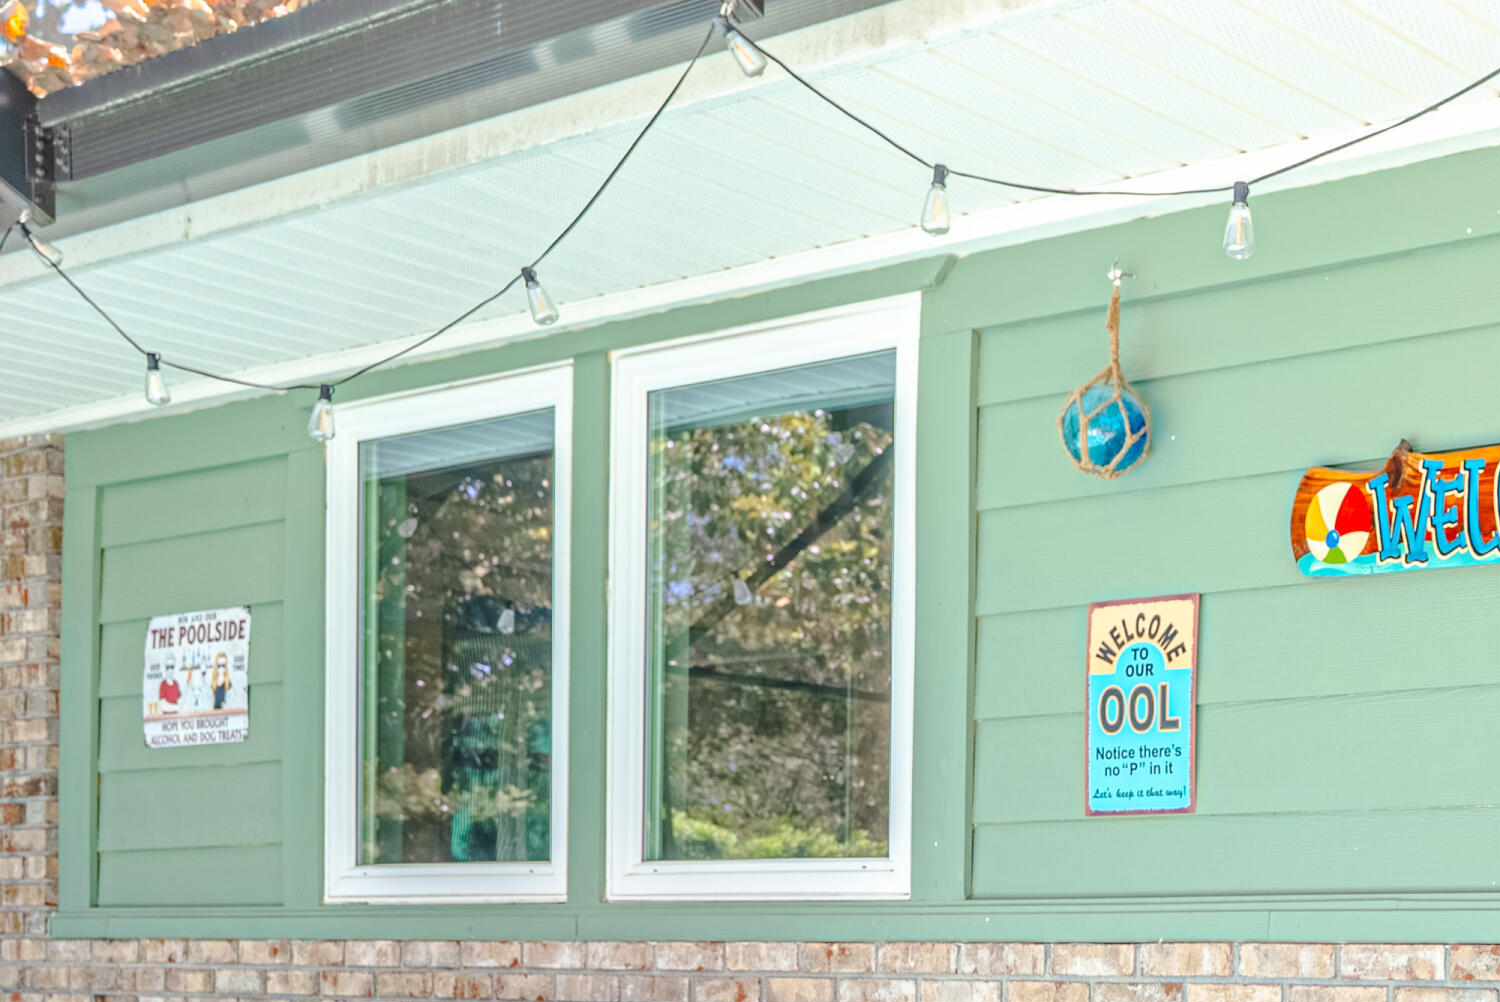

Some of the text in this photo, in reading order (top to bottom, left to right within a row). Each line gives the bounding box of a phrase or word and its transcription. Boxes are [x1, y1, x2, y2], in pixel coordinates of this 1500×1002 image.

[151, 619, 246, 649] THE POOLSIDE
[1096, 612, 1186, 665] WELCOME
[1131, 647, 1148, 660] TO
[1125, 663, 1154, 677] OUR
[1099, 683, 1180, 734] OOL
[181, 719, 194, 730] YOU
[196, 717, 229, 729] BROUGHT
[151, 729, 242, 746] ALCOHOL AND DOG TREATS
[1096, 744, 1182, 760] Notice there's
[1104, 766, 1120, 776] no
[1149, 761, 1161, 774] in
[1165, 761, 1173, 774] it
[1092, 785, 1186, 800] Let's keep it that way!
